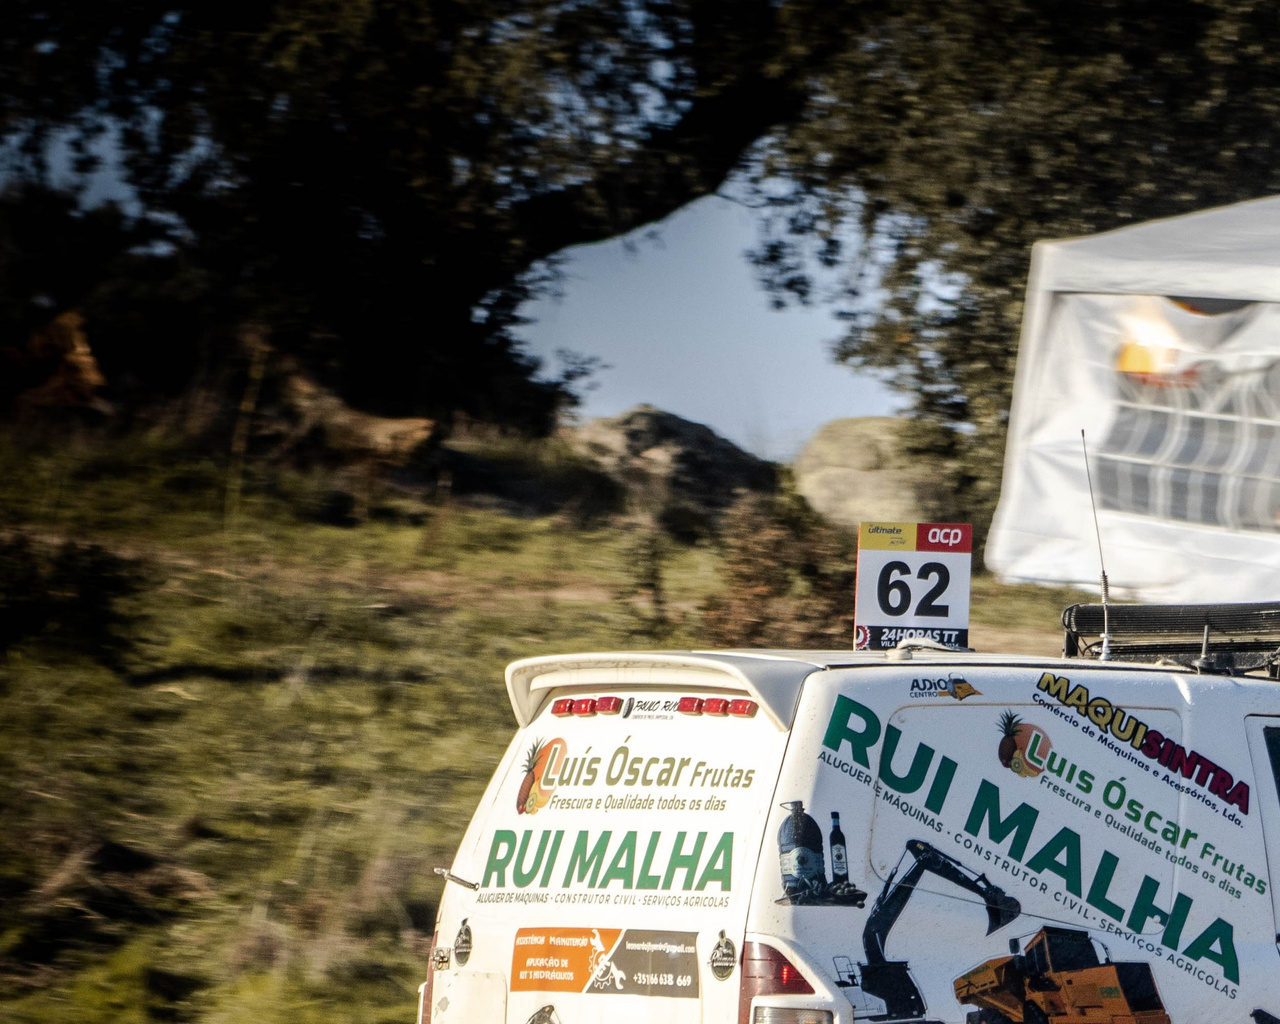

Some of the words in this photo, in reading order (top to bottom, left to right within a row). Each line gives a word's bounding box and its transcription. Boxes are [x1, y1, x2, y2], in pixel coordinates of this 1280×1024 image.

[868, 526, 902, 535] ultimate
[928, 528, 962, 546] acp
[877, 560, 950, 617] 62
[942, 631, 959, 643] TT
[541, 746, 601, 787] Luís
[606, 735, 691, 787] Óscar
[690, 761, 756, 788] Frutas
[1032, 693, 1079, 728] Comércio
[1081, 724, 1101, 738] de
[1097, 734, 1150, 772] Máquinas
[1152, 769, 1160, 779] e
[1161, 773, 1219, 814] Acessórios,
[1222, 810, 1244, 829] Lda.
[1037, 672, 1250, 815] MAQUISINTRA
[549, 794, 594, 810] Frescura
[595, 799, 601, 809] e
[604, 794, 654, 812] Qualidade
[656, 796, 686, 810] todos
[688, 799, 701, 810] os
[704, 795, 726, 811] dias
[481, 829, 565, 889] RUI
[562, 830, 734, 892] MALHA
[822, 694, 958, 816] RUI
[963, 778, 1240, 986] MALHA
[1039, 775, 1092, 814] Frescura
[1094, 809, 1101, 819] e
[1104, 814, 1163, 855] Qualidade
[1165, 849, 1199, 874] todos
[1201, 869, 1215, 884] os
[1219, 878, 1242, 900] dias
[1102, 776, 1198, 850] Óscar
[1200, 842, 1268, 895] Frutas
[476, 893, 505, 904] ALUGUER
[504, 893, 515, 903] DE
[554, 893, 610, 905] CONSTRUTOR
[614, 894, 636, 906] CIVIL
[642, 895, 681, 908] SERVIÇOS
[683, 896, 729, 908] AGRICOLAS
[817, 751, 872, 787] ALUGUER
[882, 790, 944, 833] MÁQUINAS
[954, 833, 1048, 894] CONSTRUTOR
[1053, 891, 1089, 920] CIVIL
[1098, 918, 1163, 957] SERVIÇOS
[1166, 953, 1238, 1000] AGRICOLAS
[561, 958, 569, 968] DE
[659, 974, 674, 986] 638
[676, 975, 692, 987] 669
